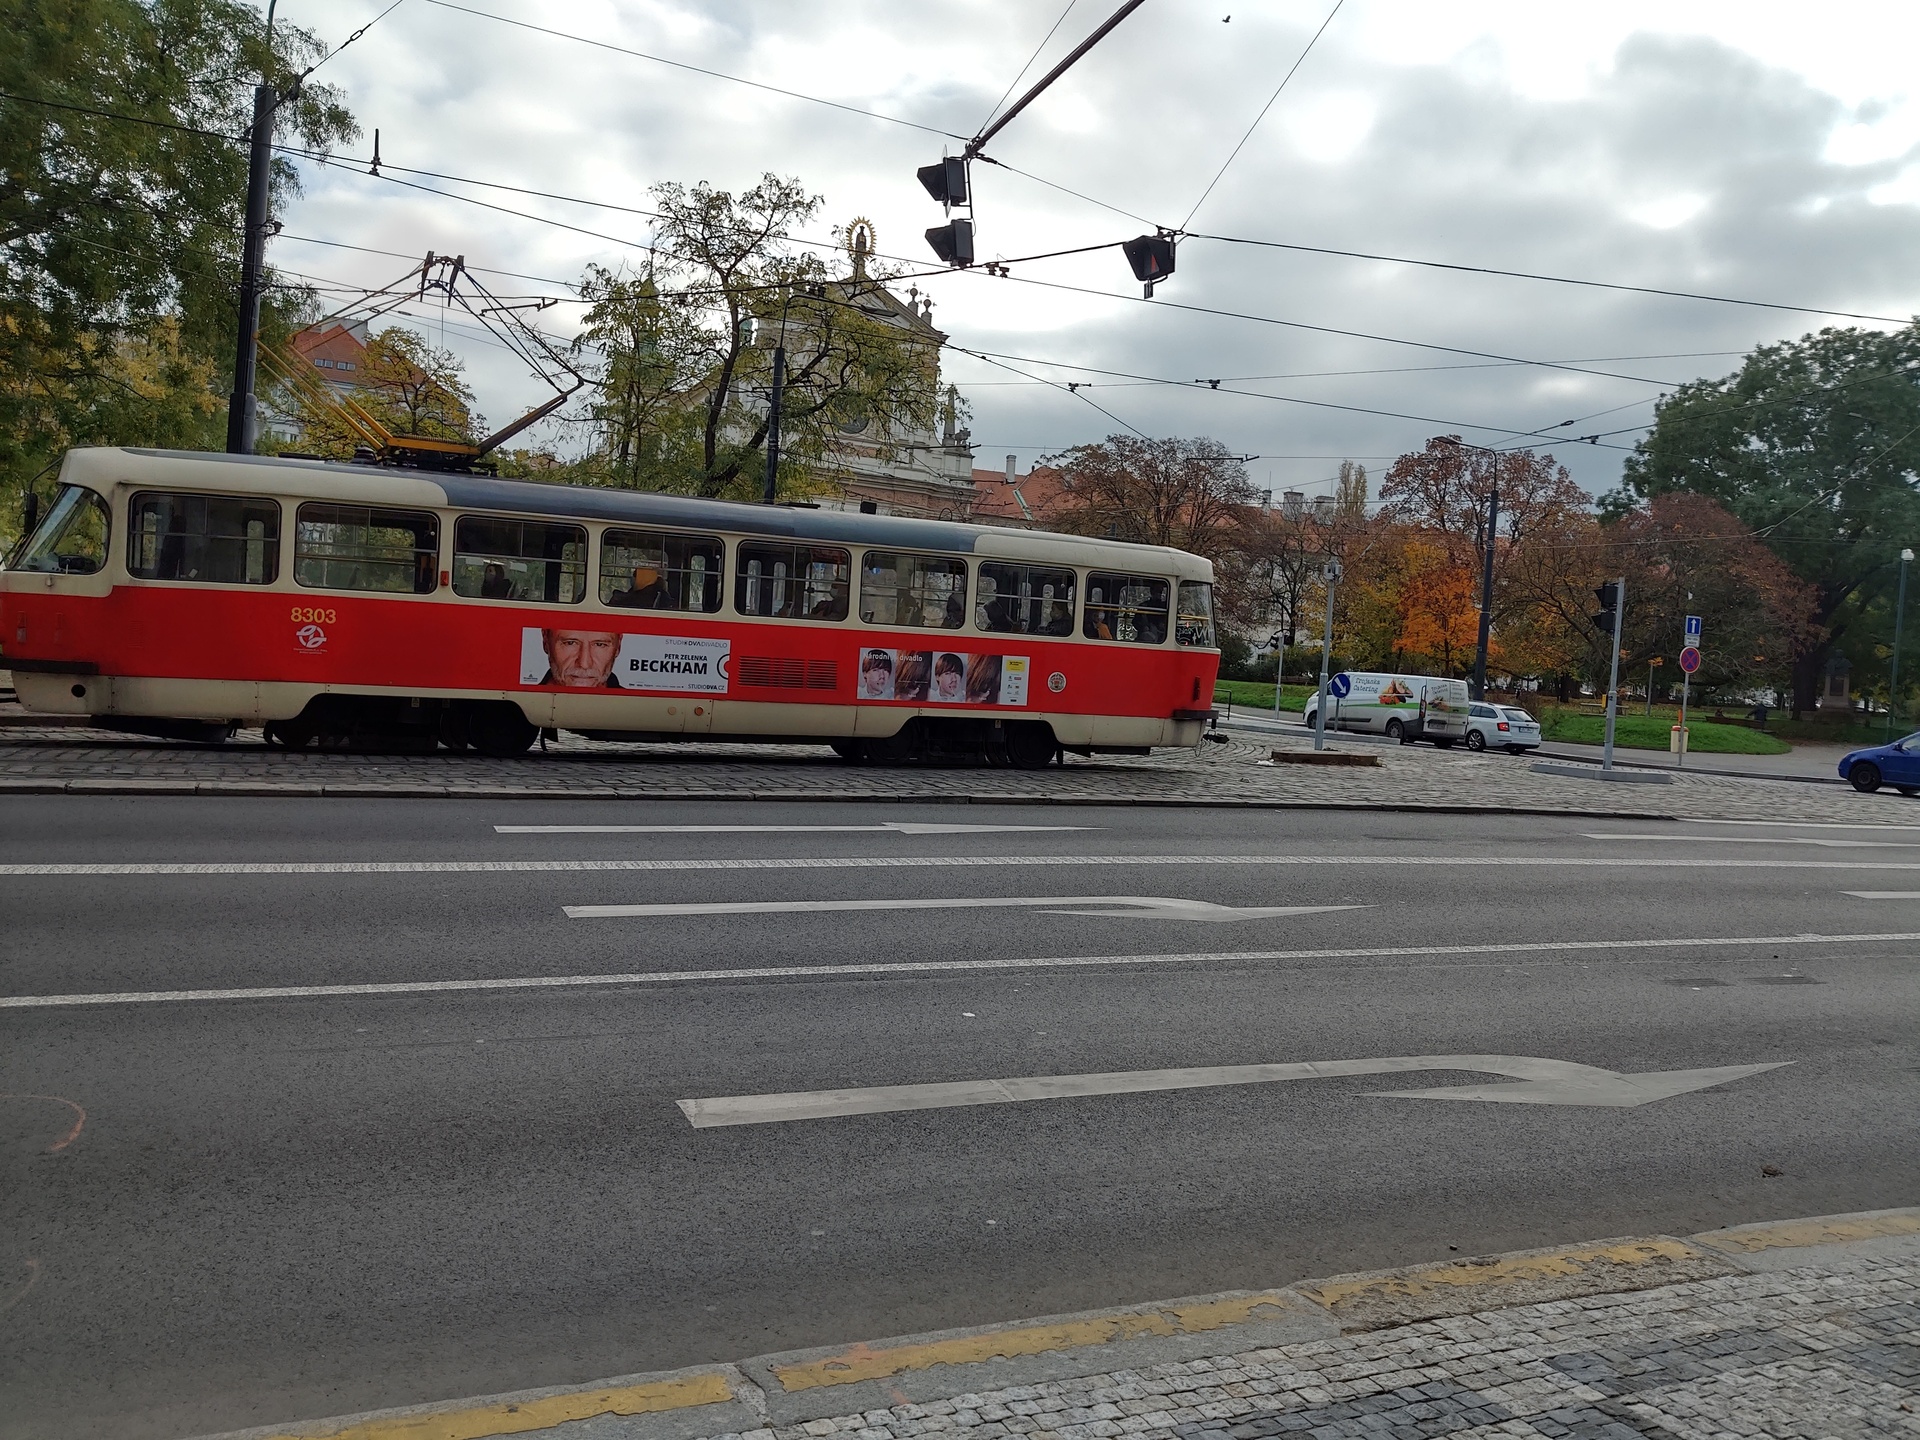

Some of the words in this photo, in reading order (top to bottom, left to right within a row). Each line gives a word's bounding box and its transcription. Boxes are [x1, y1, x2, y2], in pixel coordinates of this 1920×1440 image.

[290, 607, 336, 624] 8303
[899, 653, 923, 662] divadlo
[630, 659, 707, 674] BECKHAM
